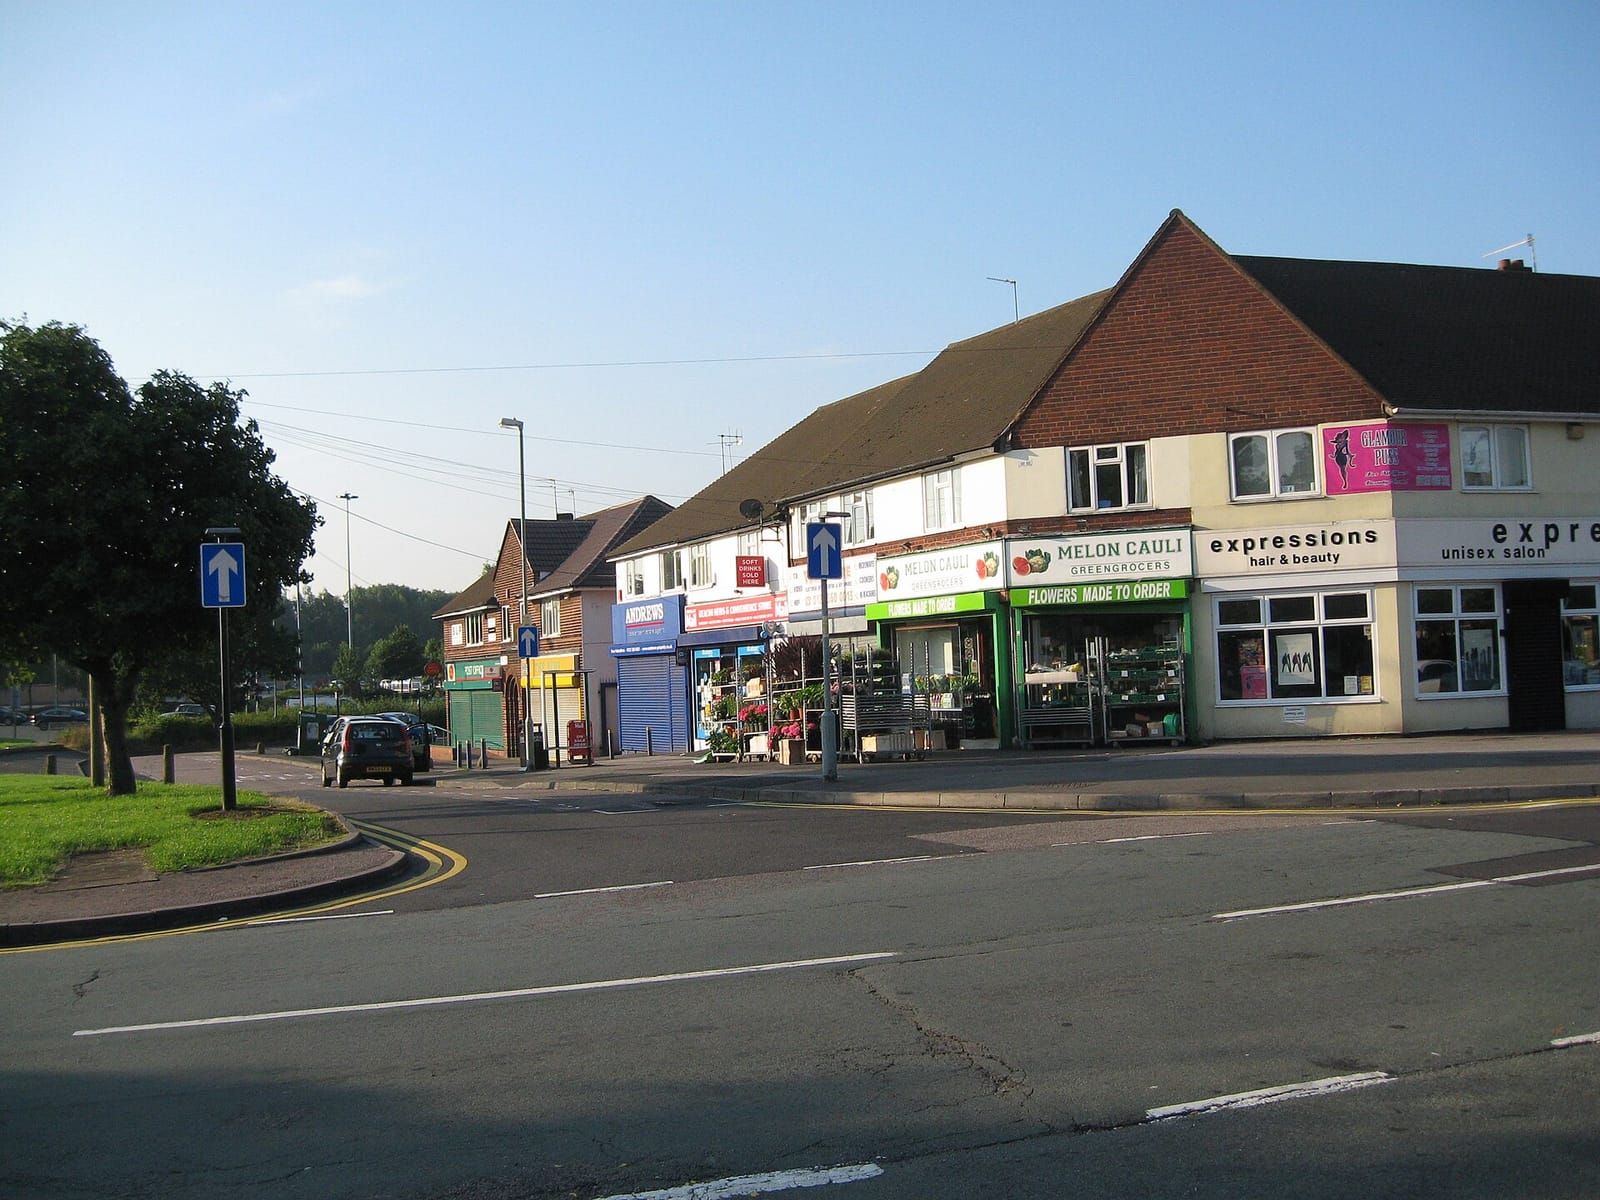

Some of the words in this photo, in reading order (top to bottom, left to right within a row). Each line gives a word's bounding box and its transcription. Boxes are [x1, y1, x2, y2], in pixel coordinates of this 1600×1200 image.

[1361, 429, 1408, 447] GLAMOUR
[1374, 448, 1399, 466] PUSS
[1058, 542, 1120, 560] MELON
[1127, 538, 1182, 555] CAULI
[1210, 530, 1378, 554] expressions
[1250, 554, 1275, 567] hair
[1279, 554, 1289, 565] &
[1293, 552, 1340, 564] beauty
[1442, 546, 1495, 559] unisex
[1503, 545, 1545, 558] salon
[905, 558, 936, 576] MELON
[939, 554, 969, 572] CAULI
[1071, 561, 1170, 575] GREENGROCERS
[911, 577, 963, 592] GREENGROCERS
[1028, 588, 1077, 605] FLOWERS
[1082, 585, 1113, 602] MADE
[1115, 584, 1130, 600] TO
[1133, 582, 1171, 598] ORDER
[625, 603, 664, 624] ANDREWS
[888, 602, 912, 617] FLOWERS
[912, 599, 928, 615] MADE
